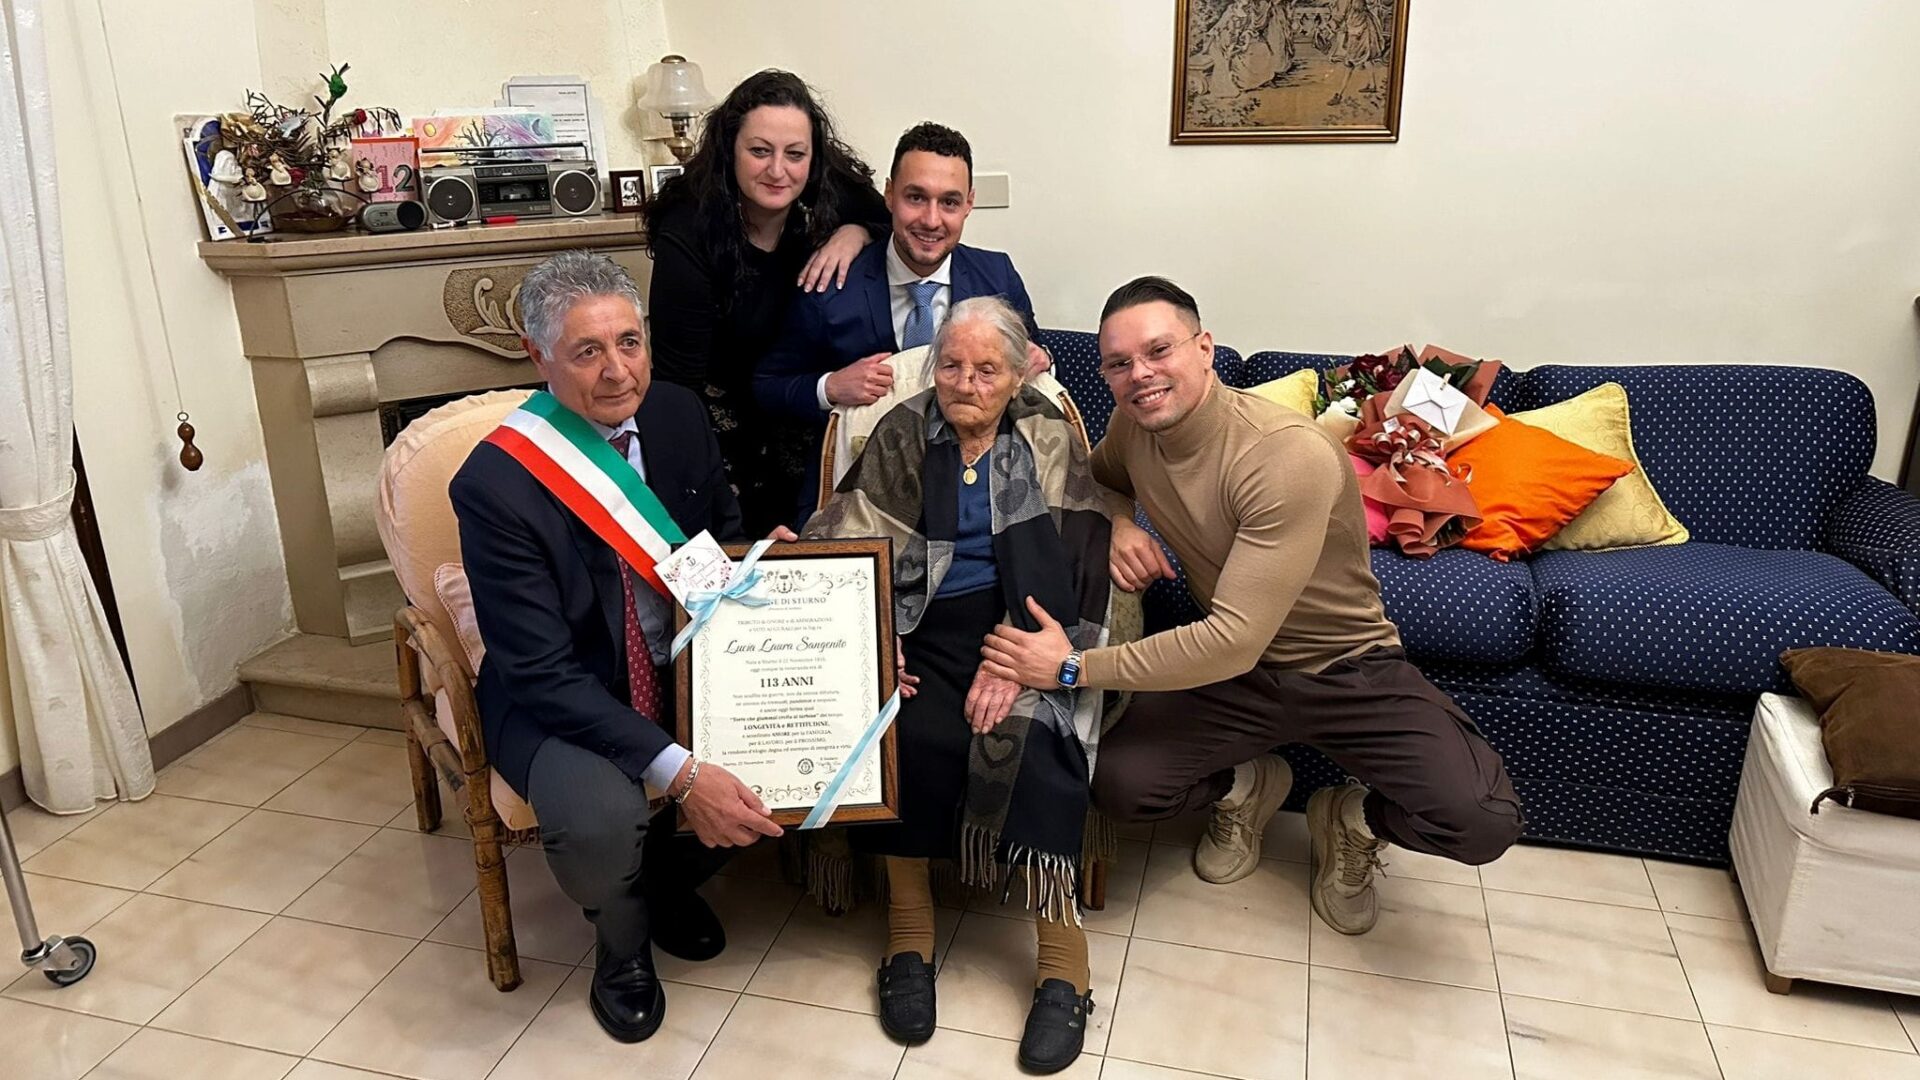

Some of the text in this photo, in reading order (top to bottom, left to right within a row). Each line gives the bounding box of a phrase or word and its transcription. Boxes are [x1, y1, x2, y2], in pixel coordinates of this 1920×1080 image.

[791, 597, 827, 605] STURNO
[723, 635, 847, 655] Lucia Laura Sangenito
[761, 676, 814, 688] 113 ANNI
